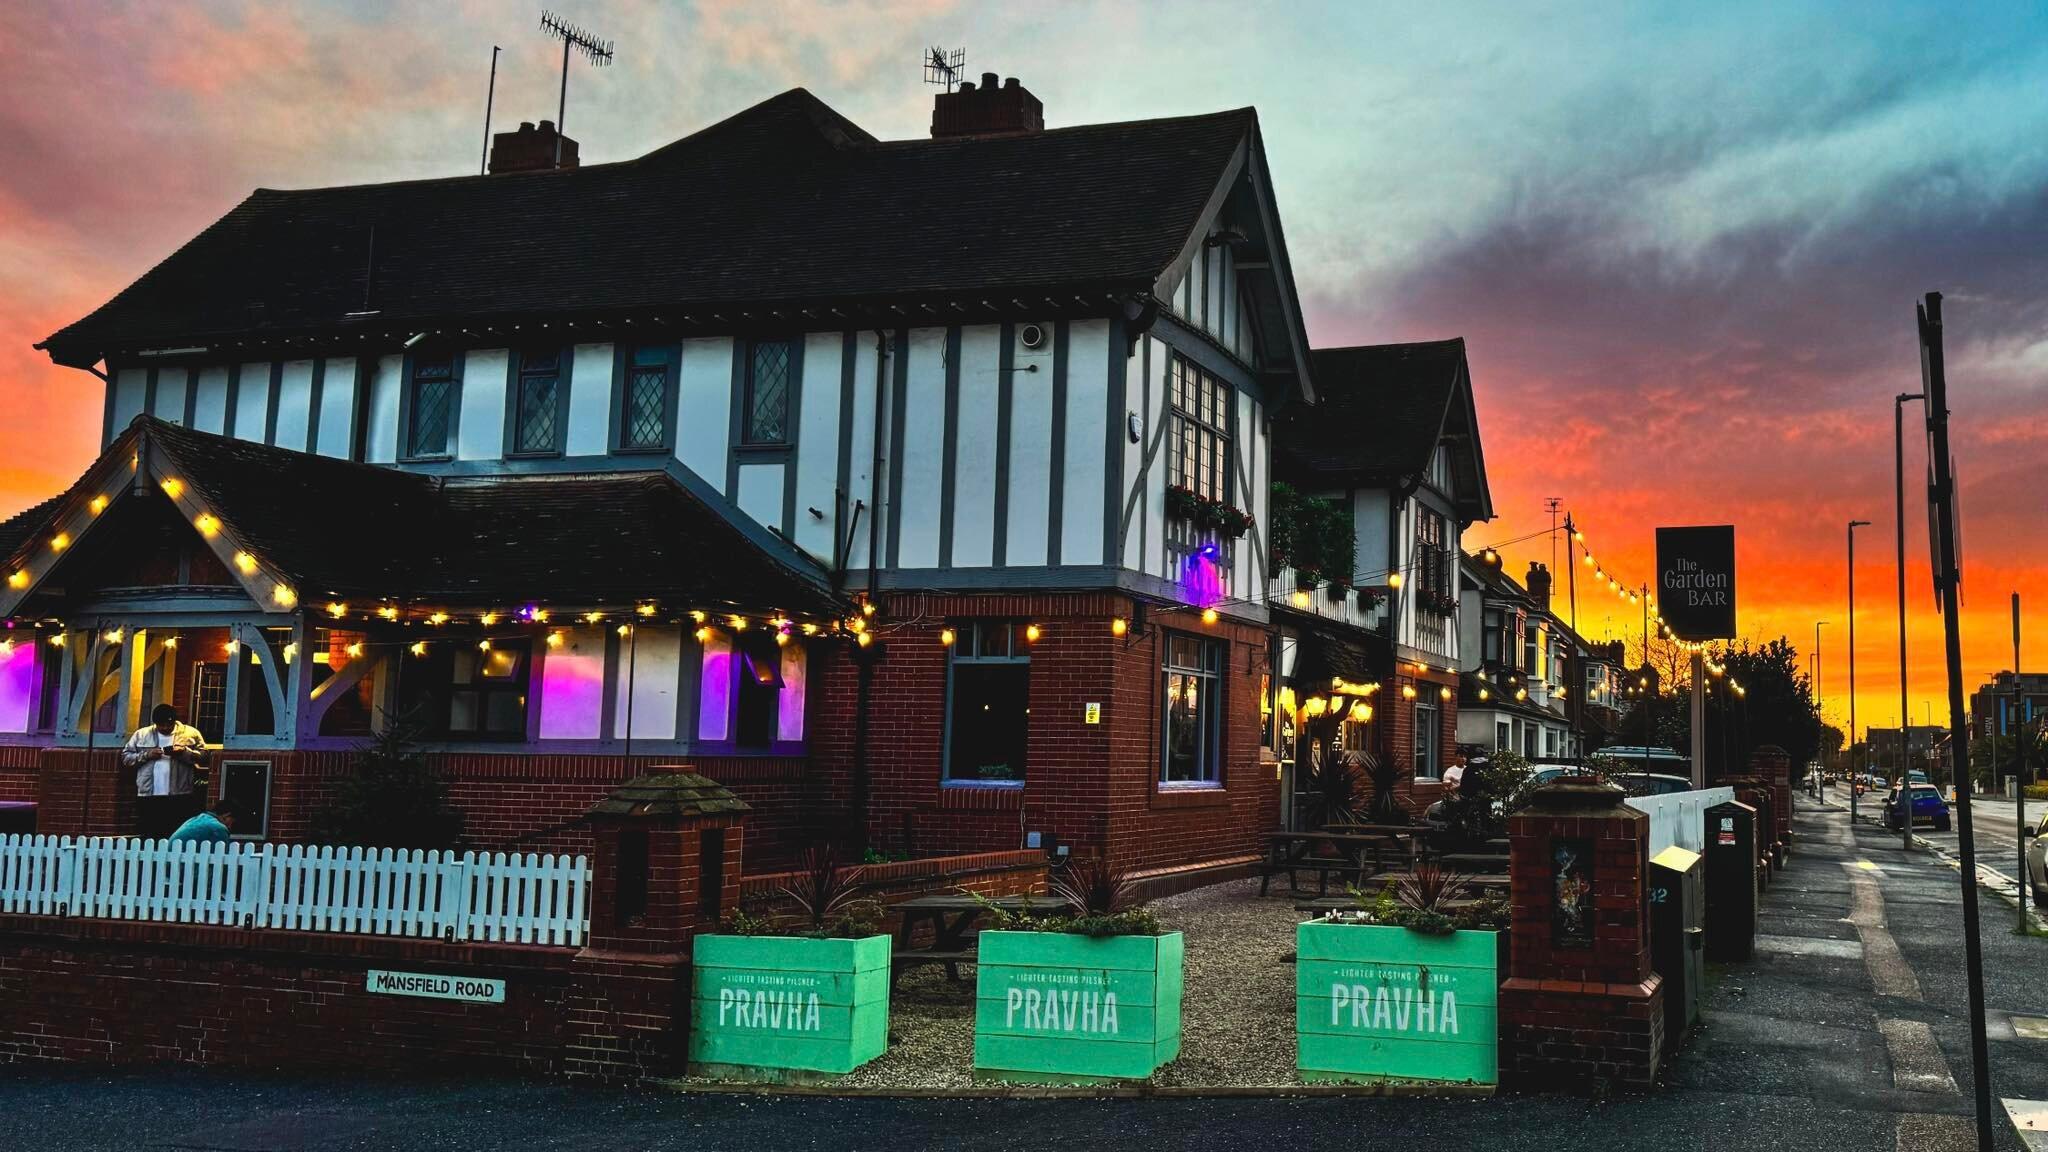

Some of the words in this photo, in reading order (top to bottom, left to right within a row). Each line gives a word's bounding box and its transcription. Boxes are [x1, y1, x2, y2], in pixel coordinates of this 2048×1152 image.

[1677, 558, 1697, 571] The
[1664, 569, 1727, 589] Garden
[1688, 590, 1727, 606] BAR
[1016, 973, 1046, 983] LIGHTER
[1049, 974, 1079, 984] TASTING
[1341, 967, 1374, 978] LIGHTER
[377, 975, 450, 993] MANSFIELD
[455, 981, 494, 998] ROAD
[719, 988, 820, 1031] PRAVHA
[1006, 987, 1118, 1034] PRAVHA
[1332, 983, 1459, 1035] PRAVHA
